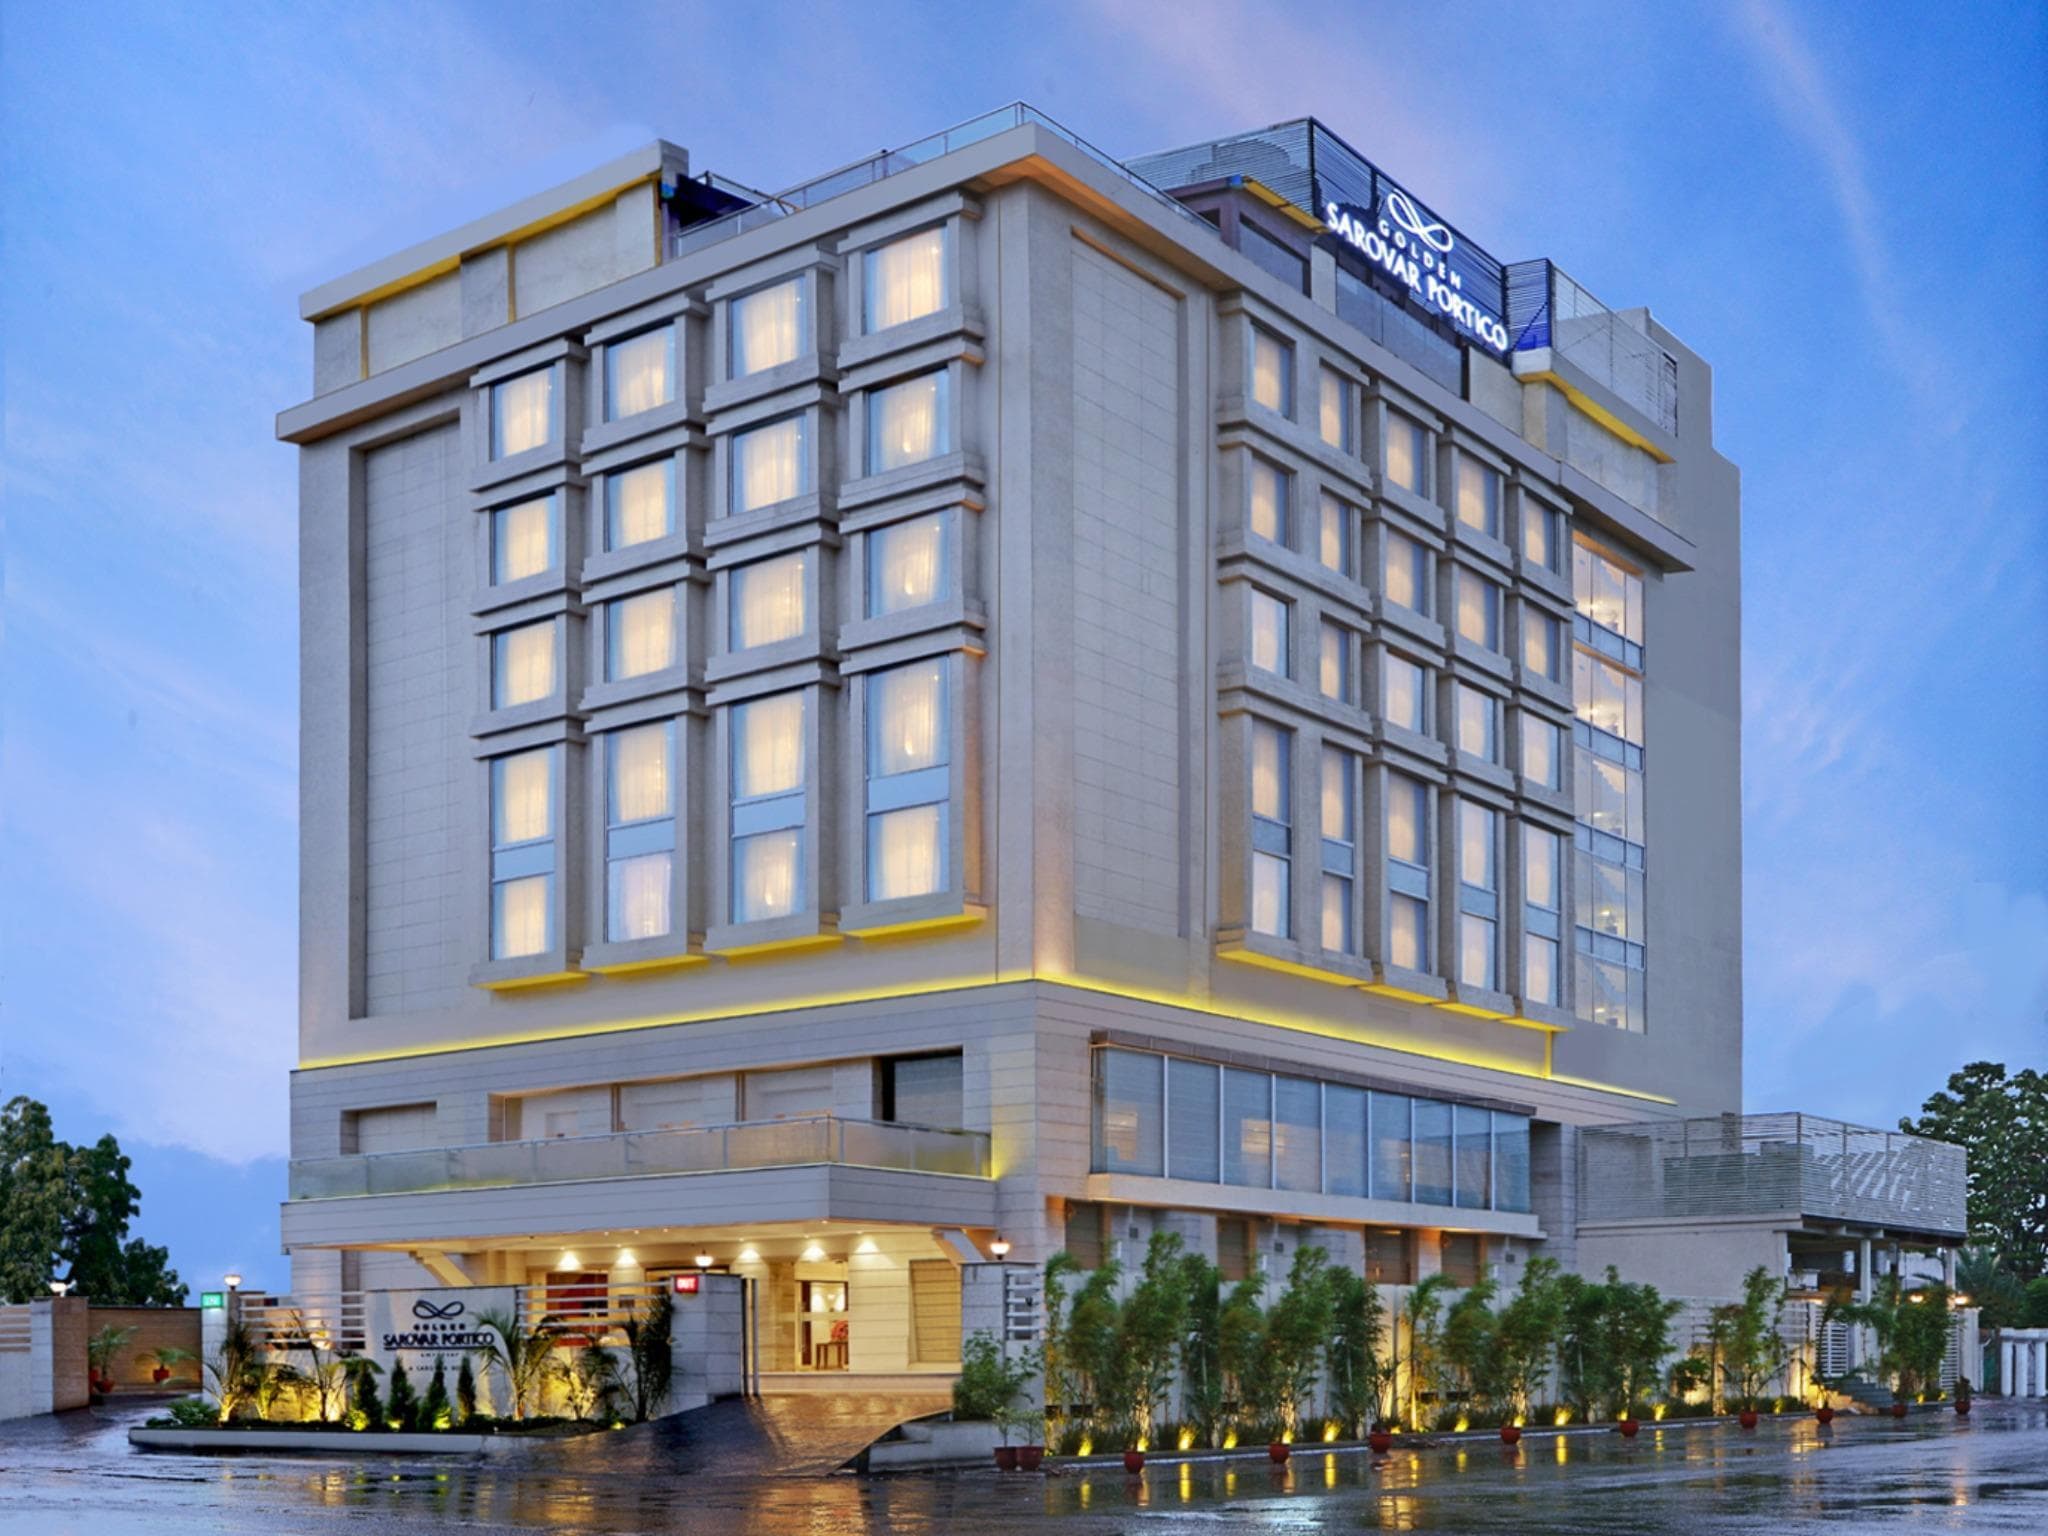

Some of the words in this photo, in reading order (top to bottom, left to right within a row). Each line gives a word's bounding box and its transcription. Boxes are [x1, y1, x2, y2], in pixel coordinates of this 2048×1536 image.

[1326, 201, 1422, 293] SAROVAR
[1427, 275, 1508, 351] PORTICO
[1379, 219, 1461, 290] GOLDEN
[383, 1333, 438, 1346] SAROVAR
[442, 1332, 495, 1345] PORTICO
